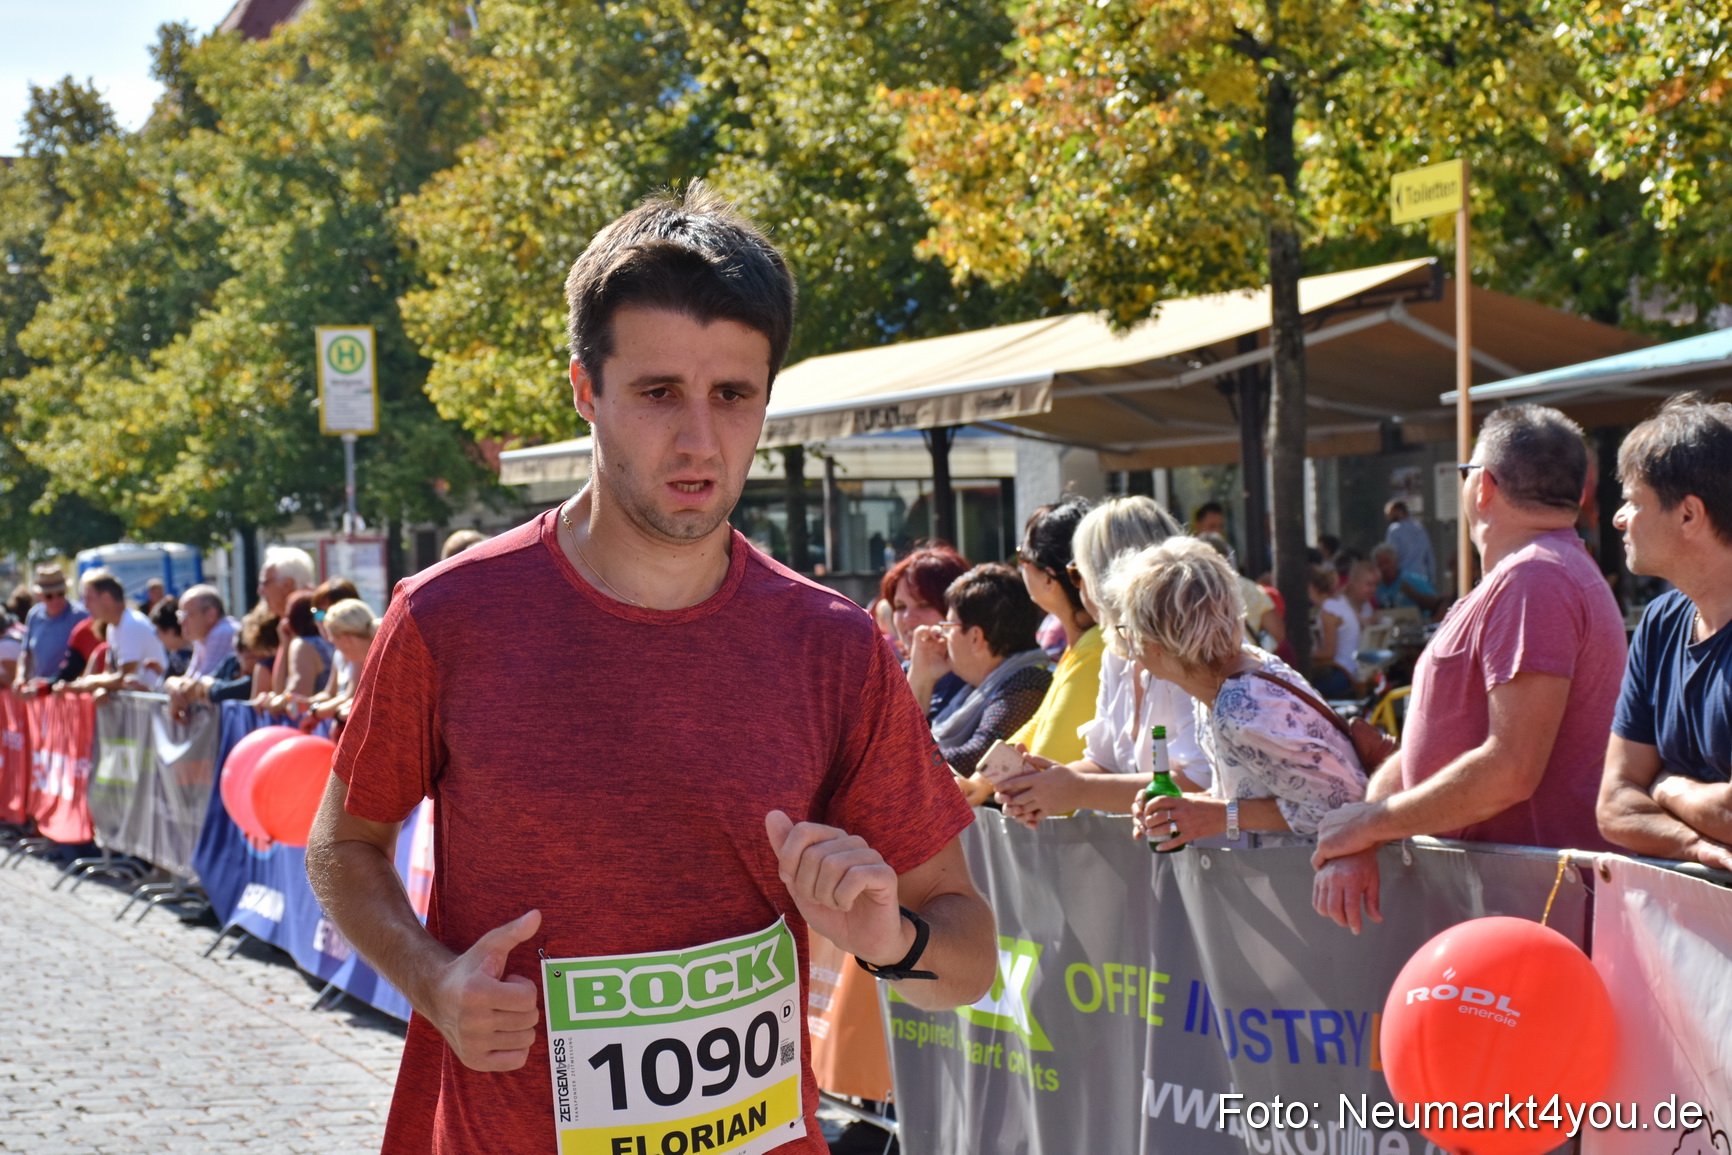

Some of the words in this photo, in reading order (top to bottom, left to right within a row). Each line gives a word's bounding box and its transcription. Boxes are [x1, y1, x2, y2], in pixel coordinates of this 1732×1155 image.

[1404, 181, 1457, 205] Toiletten
[569, 938, 780, 1017] BOCK
[783, 1005, 791, 1018] D
[1458, 1005, 1517, 1027] energie
[887, 1015, 956, 1049] nspired
[588, 1011, 779, 1111] 1090
[611, 1101, 767, 1155] FLORIAN
